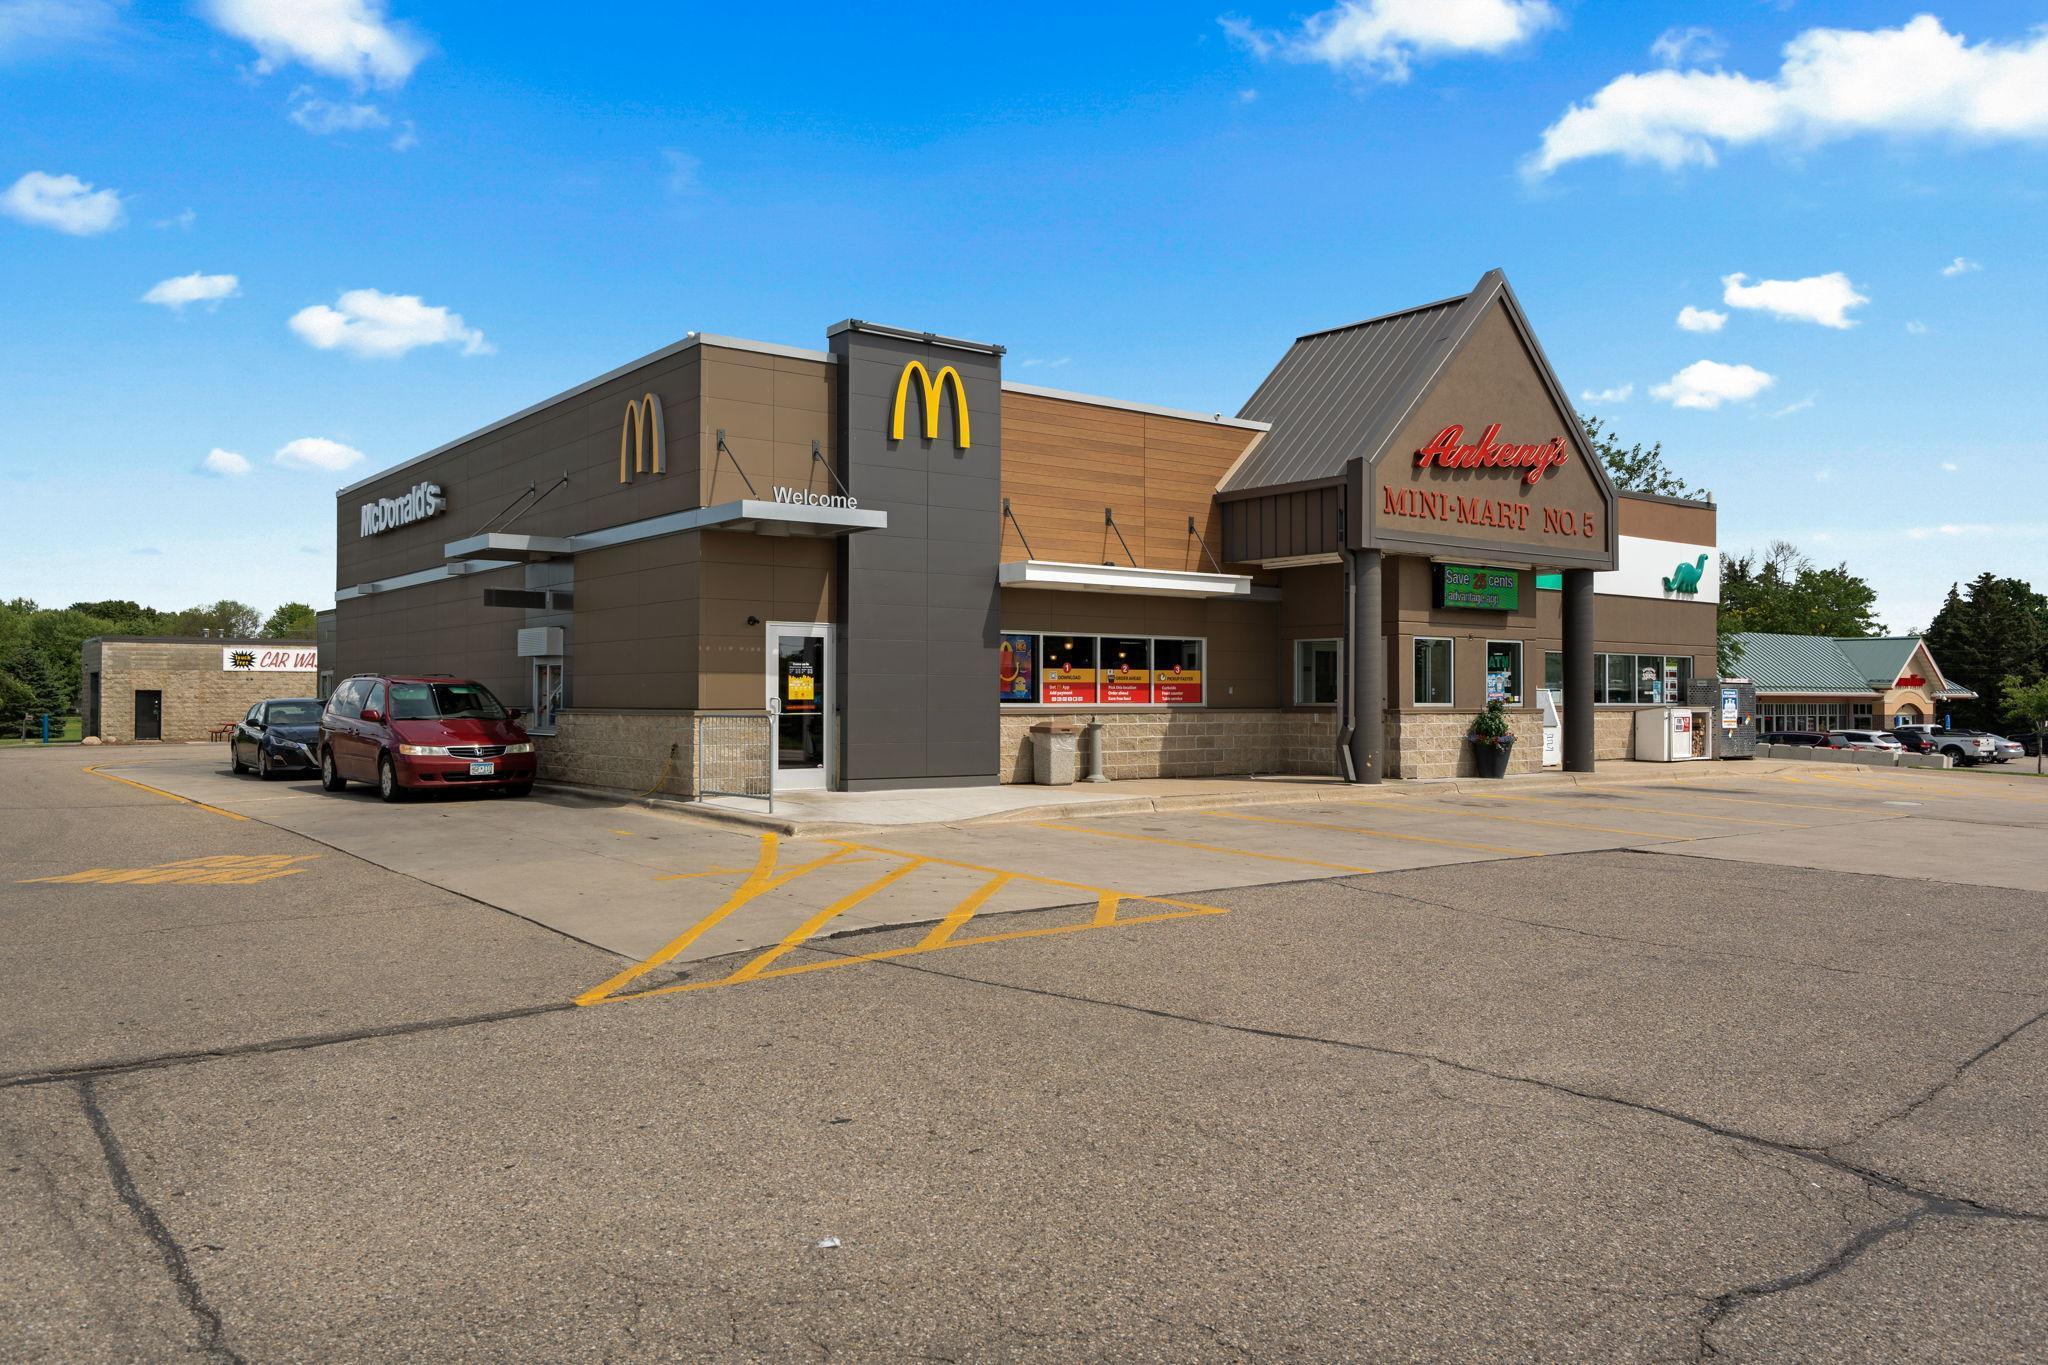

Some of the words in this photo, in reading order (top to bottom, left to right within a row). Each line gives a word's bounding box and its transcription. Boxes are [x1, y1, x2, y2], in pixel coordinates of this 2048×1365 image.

[1415, 423, 1569, 485] Ankeny's
[360, 481, 447, 538] McDonald's
[772, 485, 858, 509] Welcome
[1383, 484, 1530, 530] MINI-MART
[1583, 512, 1596, 538] 5
[1446, 569, 1470, 585] Save
[1472, 573, 1487, 589] 25
[1488, 576, 1513, 588] cents
[260, 651, 290, 668] CAR
[293, 652, 318, 668] WA
